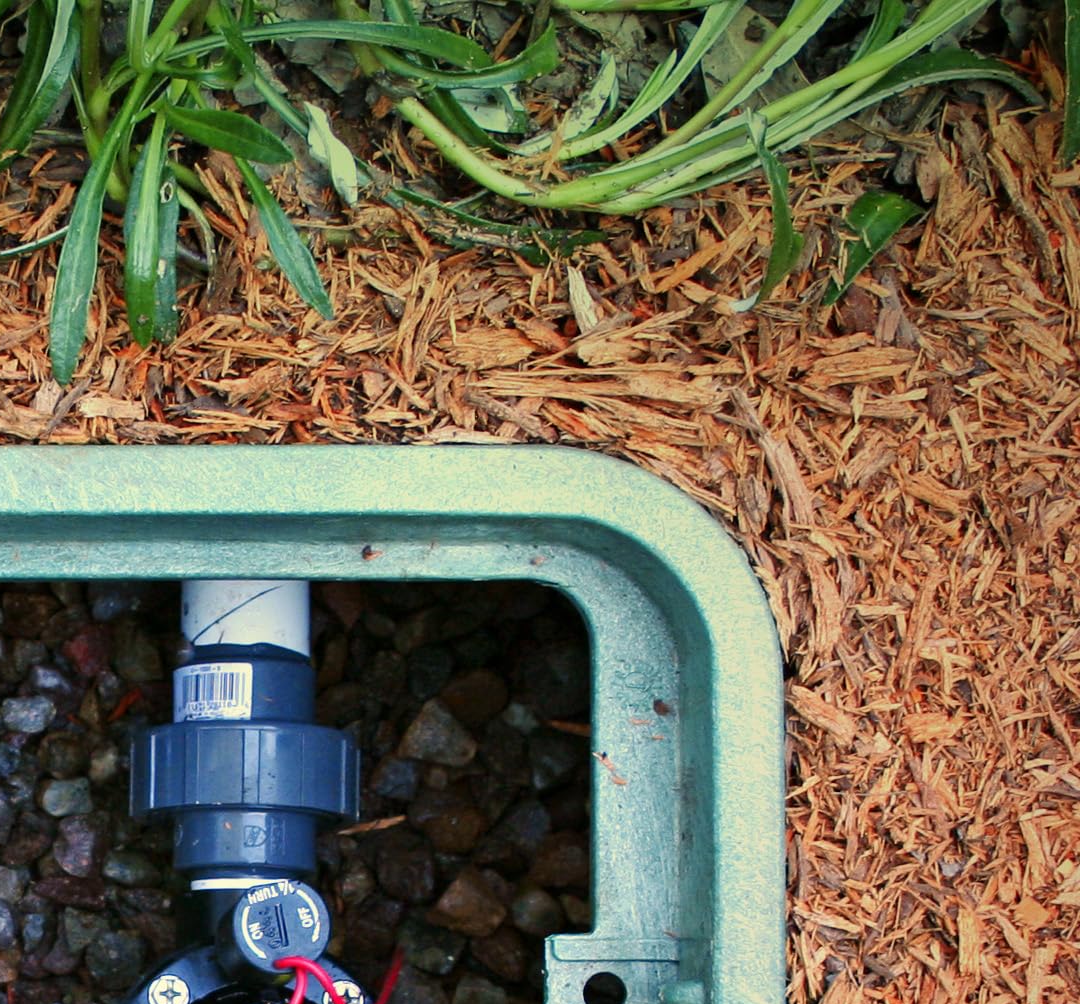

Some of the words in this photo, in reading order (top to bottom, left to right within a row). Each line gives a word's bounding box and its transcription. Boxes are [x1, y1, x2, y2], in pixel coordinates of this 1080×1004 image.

[247, 886, 278, 905] TURN
[297, 906, 314, 929] OFF
[248, 921, 264, 940] ON
